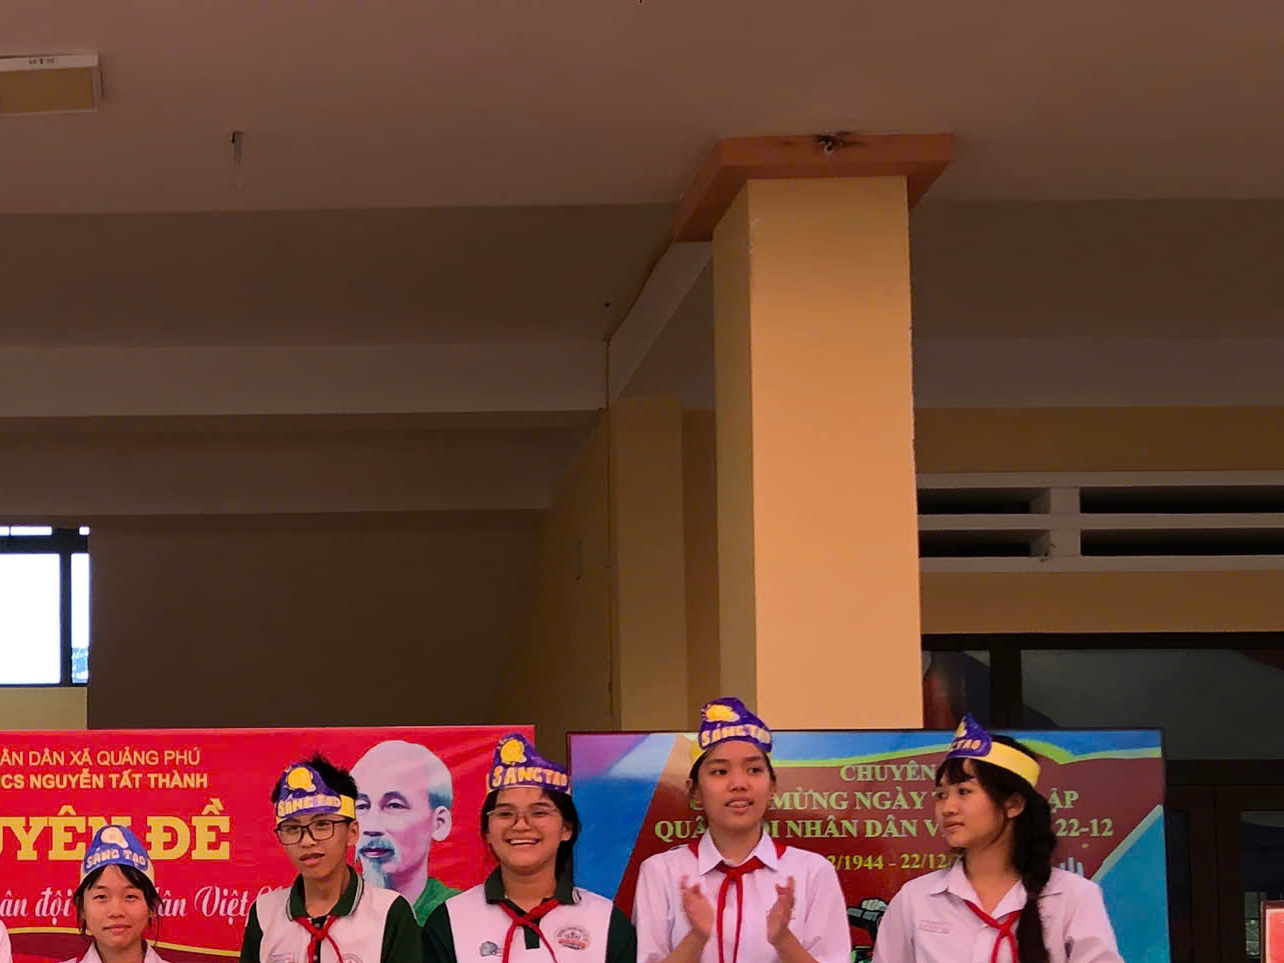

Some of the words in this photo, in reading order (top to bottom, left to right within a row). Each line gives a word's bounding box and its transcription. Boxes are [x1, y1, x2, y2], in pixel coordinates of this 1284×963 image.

[28, 748, 65, 767] DÂN
[69, 748, 93, 767] XÃ
[96, 747, 159, 767] QUẢNG
[164, 747, 200, 766] PHÚ
[29, 768, 105, 789] NGUYỄN
[108, 769, 143, 789] TẤT
[147, 769, 207, 789] THÀNH
[840, 760, 936, 781] CHUYÊN
[769, 787, 848, 810] MỪNG
[853, 786, 927, 810] NGÀY
[147, 798, 230, 861] ĐỀ
[655, 816, 707, 842] QUÂ
[786, 815, 859, 838] NHÂN
[864, 814, 918, 838] DÂN
[1055, 818, 1114, 837] 22-12
[35, 887, 73, 925] đội
[194, 886, 249, 925] Việt
